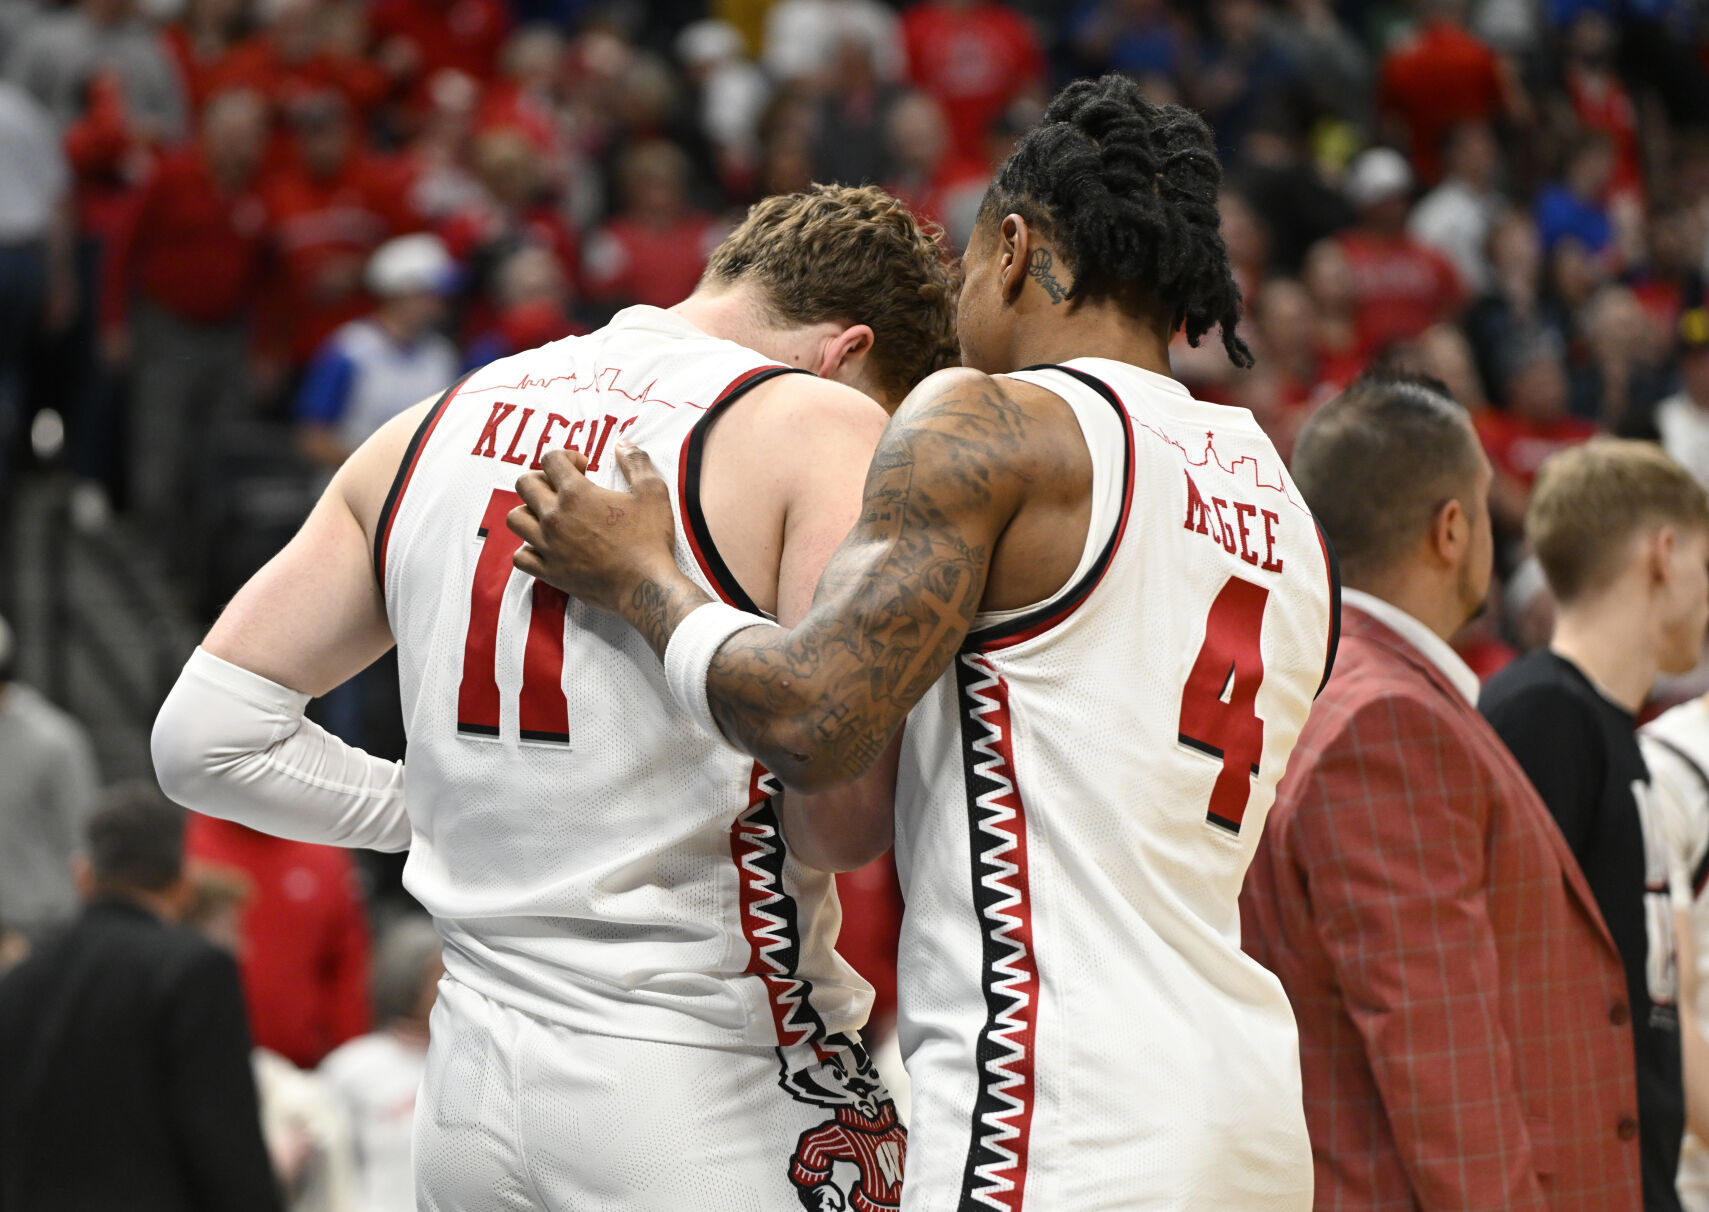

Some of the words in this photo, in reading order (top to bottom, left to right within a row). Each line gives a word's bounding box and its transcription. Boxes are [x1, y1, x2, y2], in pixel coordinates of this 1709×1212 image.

[457, 488, 572, 744] 11
[1178, 575, 1270, 836] 4
[875, 1141, 903, 1190] W
